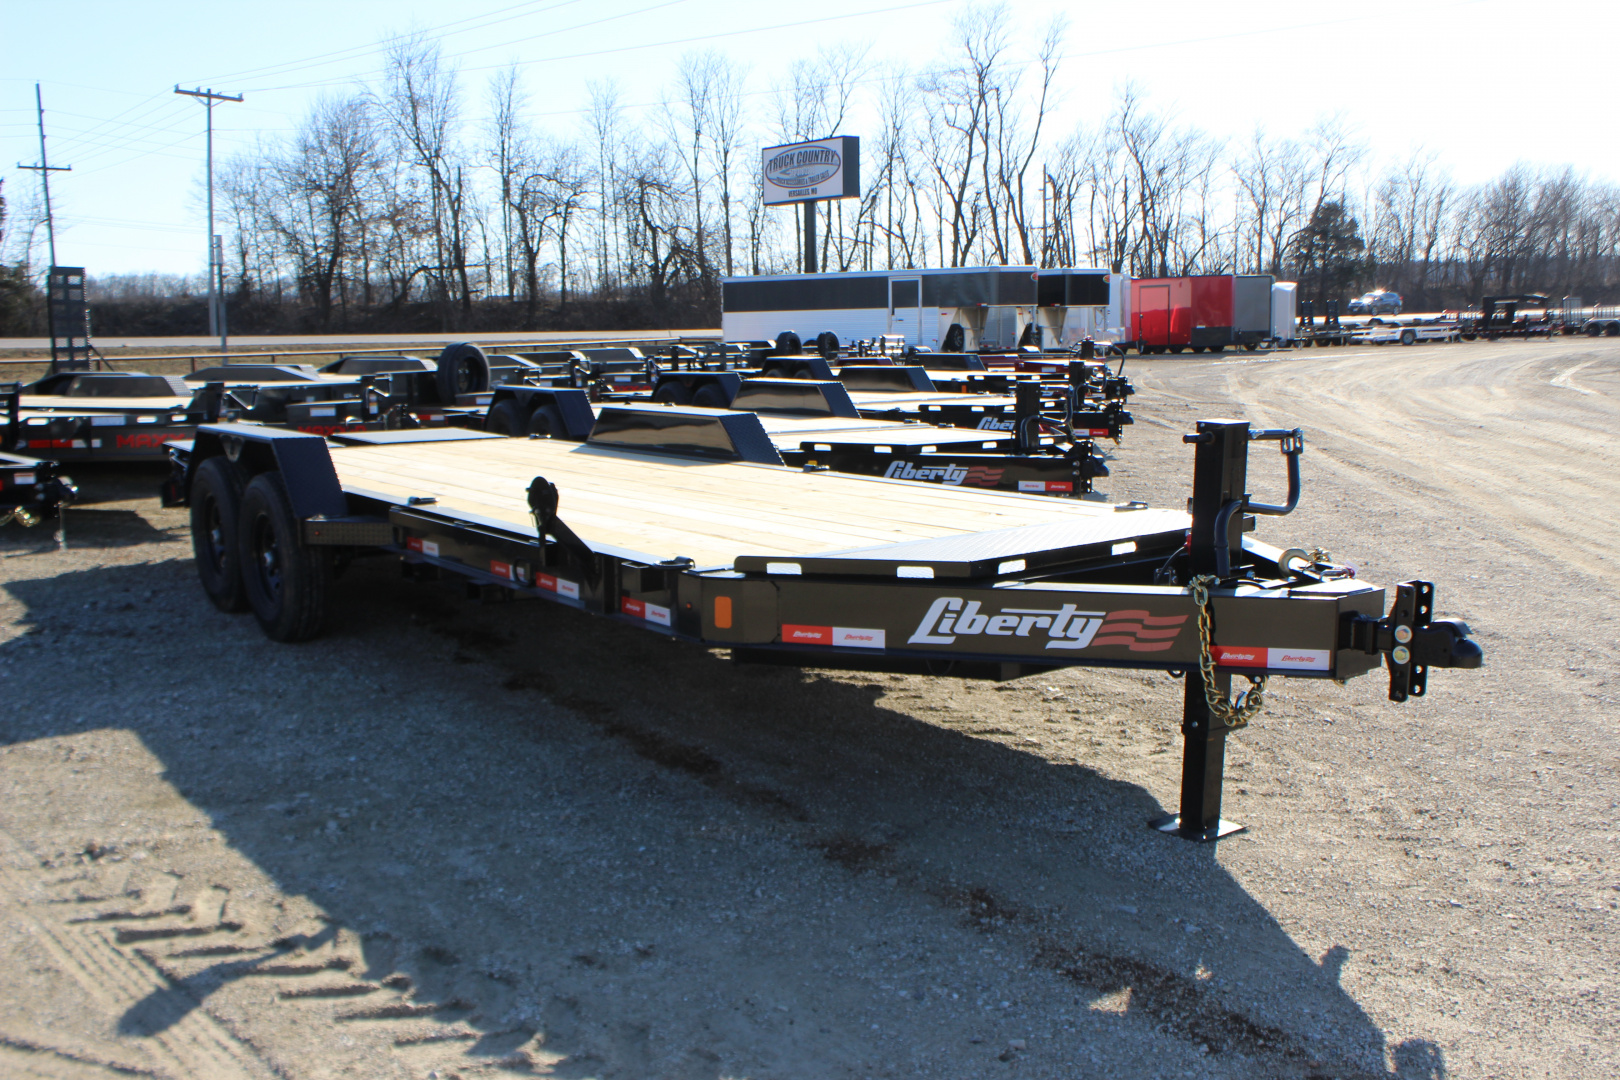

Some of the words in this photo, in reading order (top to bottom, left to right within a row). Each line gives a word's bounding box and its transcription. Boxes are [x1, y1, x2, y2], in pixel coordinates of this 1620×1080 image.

[769, 153, 795, 173] TRUCK
[796, 150, 836, 163] COUNTRY
[884, 460, 969, 486] Liberty
[907, 597, 1107, 650] Liberty
